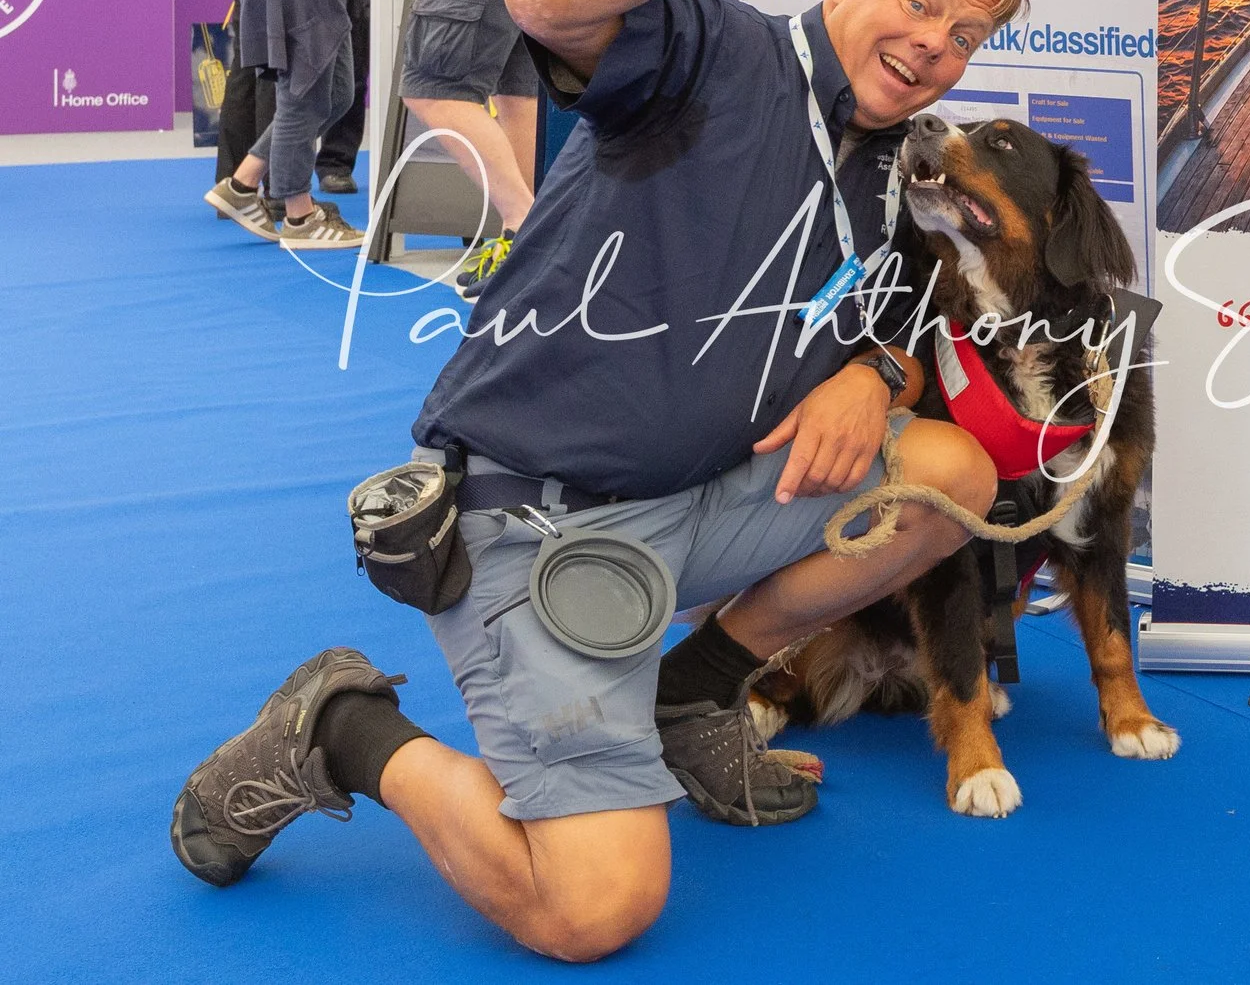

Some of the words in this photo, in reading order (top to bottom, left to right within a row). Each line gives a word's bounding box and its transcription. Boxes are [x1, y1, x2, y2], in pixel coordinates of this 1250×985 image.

[982, 22, 1158, 58] .uk/classified
[61, 94, 104, 107] Home
[106, 93, 149, 106] Office
[826, 268, 856, 300] EXHIBITOR
